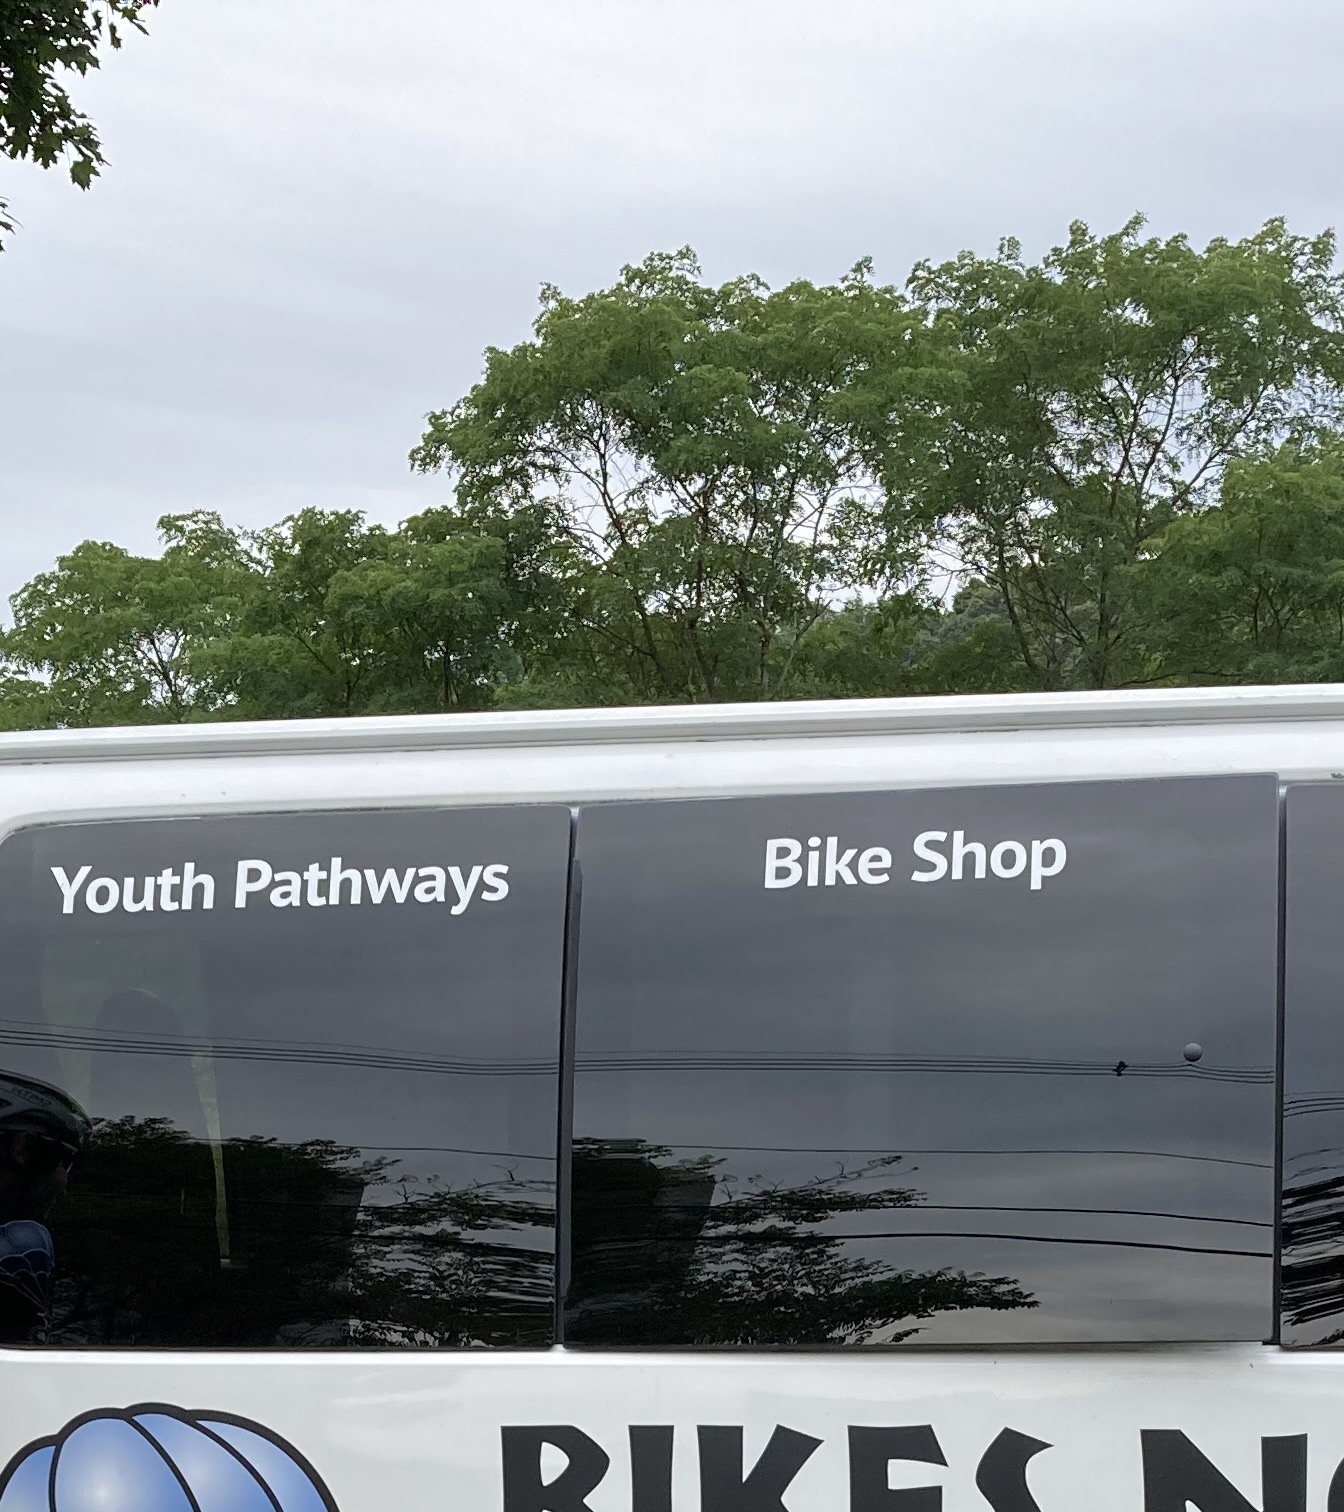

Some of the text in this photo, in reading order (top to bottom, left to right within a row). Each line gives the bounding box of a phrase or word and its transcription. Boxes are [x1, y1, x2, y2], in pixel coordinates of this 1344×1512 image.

[50, 857, 510, 915] Youth Pathways
[764, 830, 1067, 890] Bike Shop
